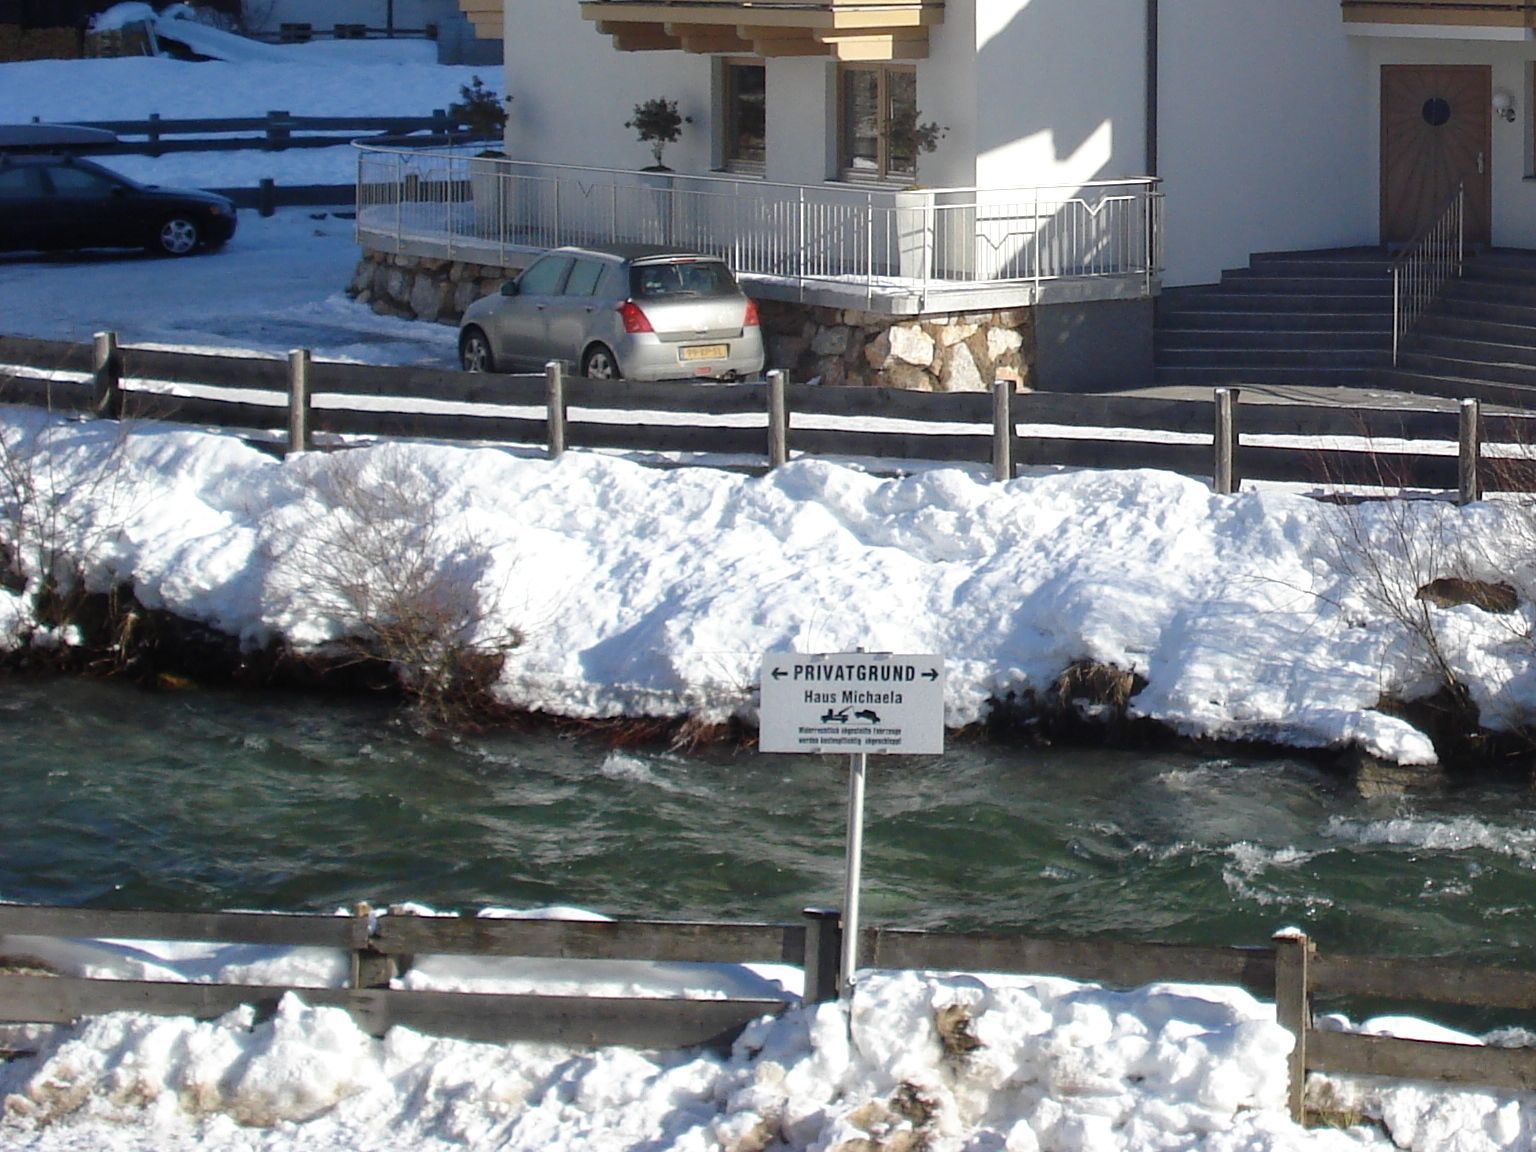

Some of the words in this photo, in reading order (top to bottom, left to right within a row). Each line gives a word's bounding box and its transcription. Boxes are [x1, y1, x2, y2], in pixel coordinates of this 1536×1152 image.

[793, 664, 916, 682] PRIVATGRUND
[804, 690, 837, 704] Haus
[842, 690, 903, 704] Michaela
